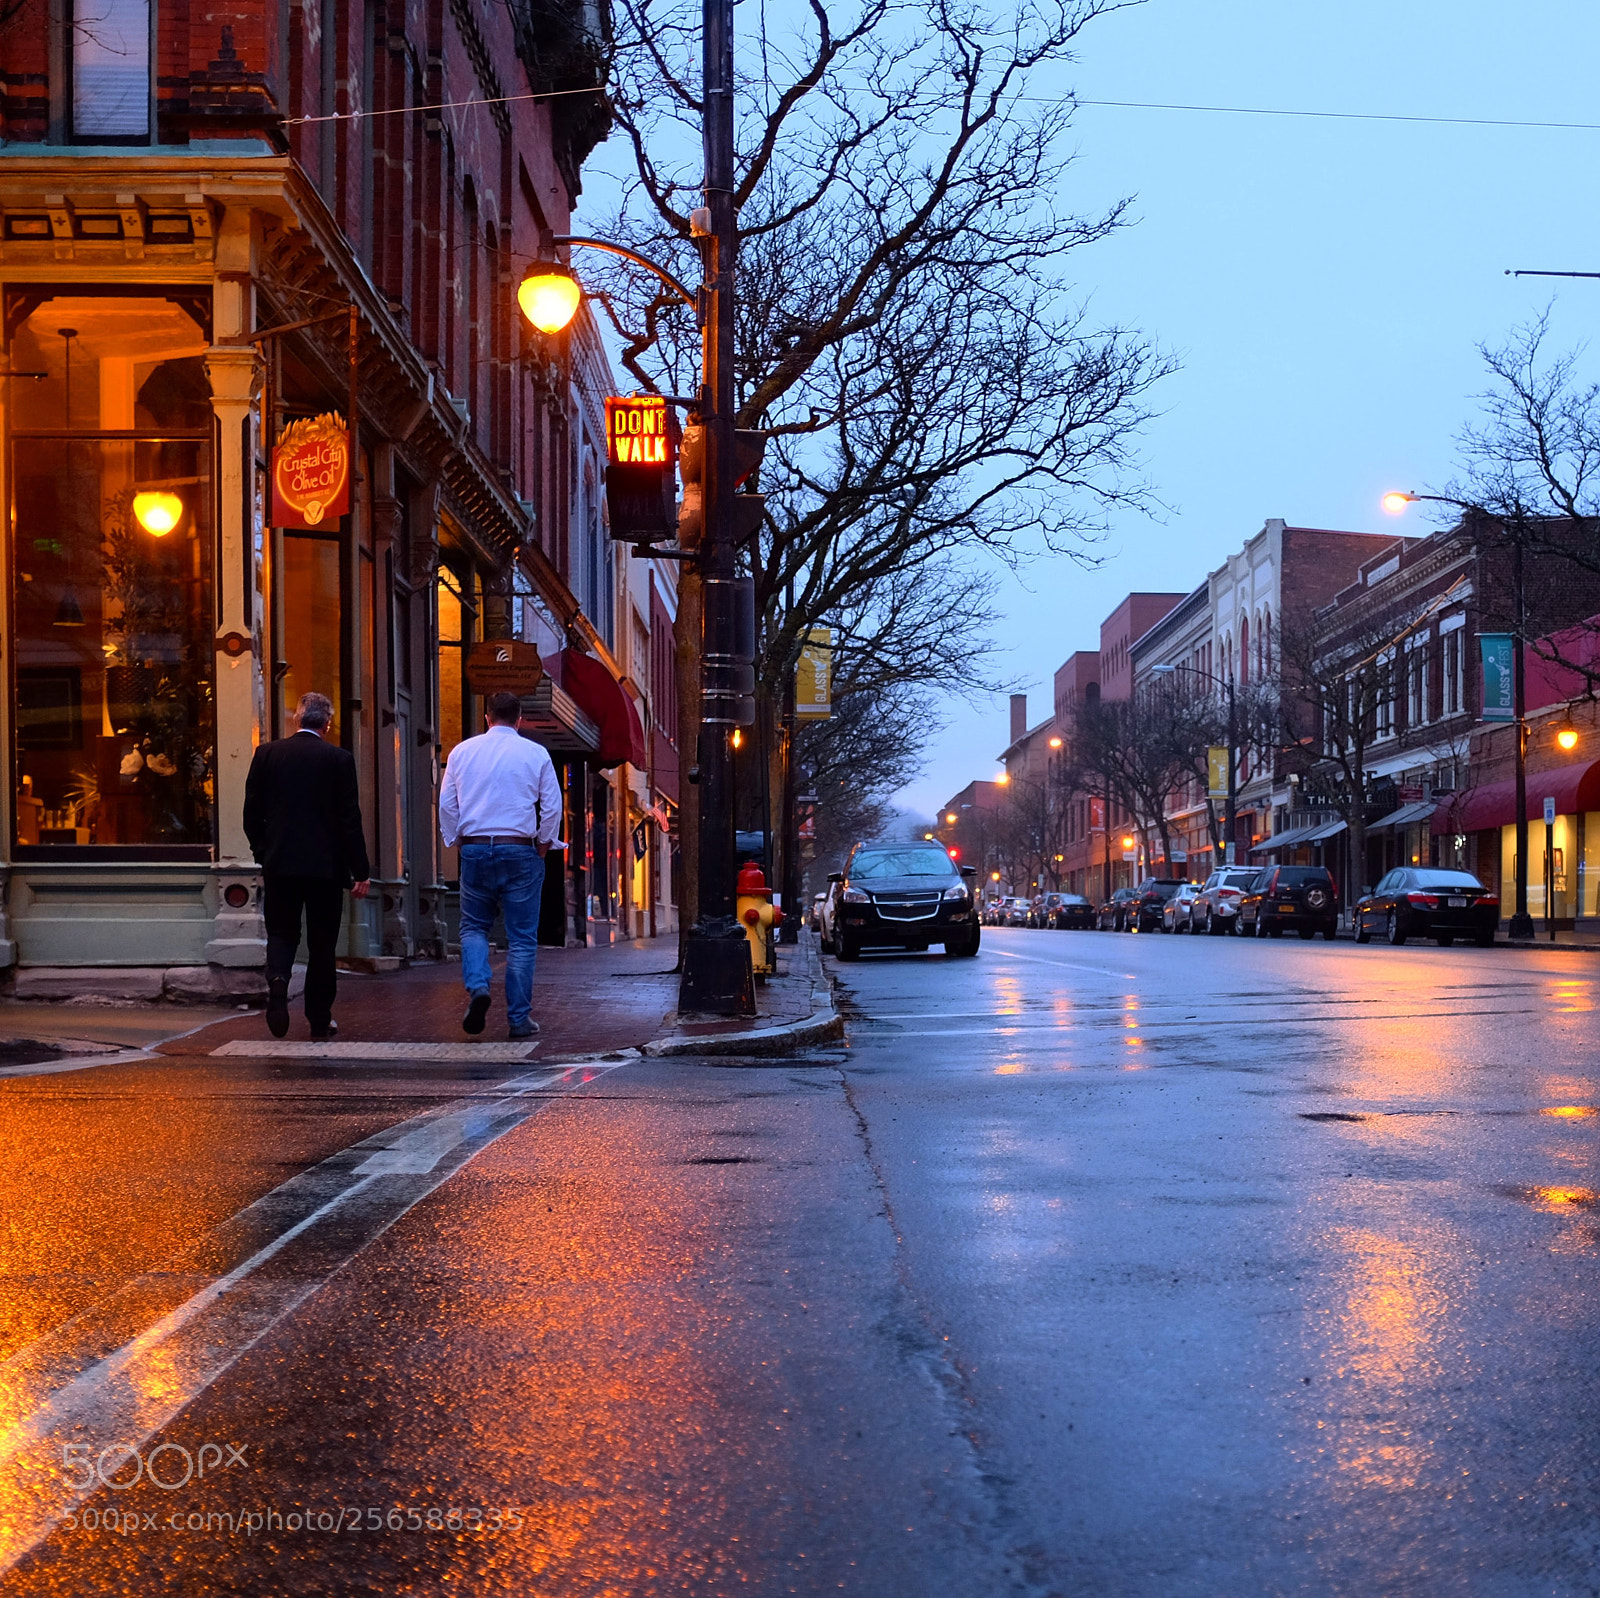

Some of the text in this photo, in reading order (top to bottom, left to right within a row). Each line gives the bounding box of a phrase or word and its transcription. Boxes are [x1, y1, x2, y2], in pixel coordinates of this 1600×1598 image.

[615, 410, 665, 434] DONT
[283, 446, 342, 477] Crystal City
[615, 437, 666, 462] WALK
[291, 465, 335, 491] Olive Oil
[814, 672, 827, 703] GLASS
[1497, 645, 1511, 707] GLASS FEST
[1307, 794, 1374, 806] THATE
